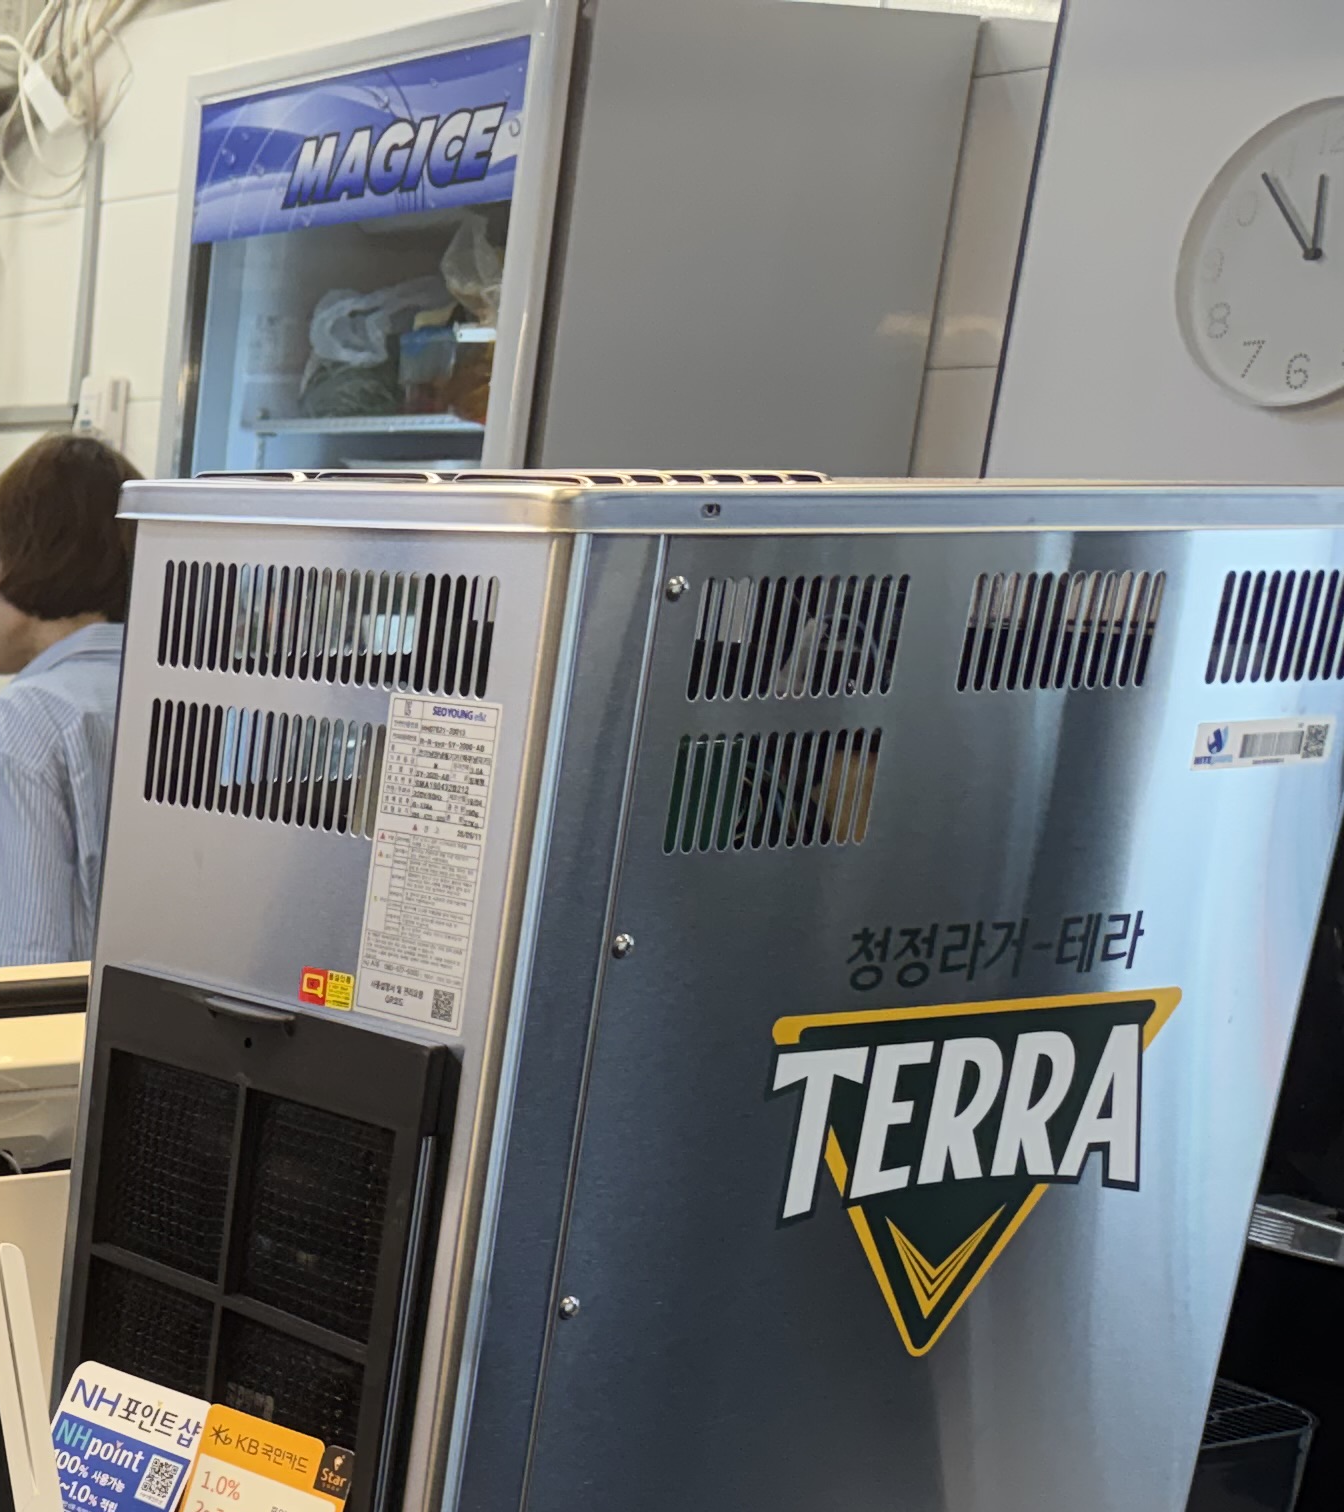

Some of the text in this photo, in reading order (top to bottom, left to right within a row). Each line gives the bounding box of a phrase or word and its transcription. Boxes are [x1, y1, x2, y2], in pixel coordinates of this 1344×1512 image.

[281, 103, 509, 209] MAGICE
[1241, 339, 1266, 379] 7
[1285, 353, 1311, 390] 6
[845, 910, 1145, 992] 청정라거-테라
[771, 1021, 1142, 1221] TERRA
[55, 1418, 145, 1473] NHpoint
[200, 1470, 241, 1501] 1.0%
[319, 1466, 348, 1489] Star
